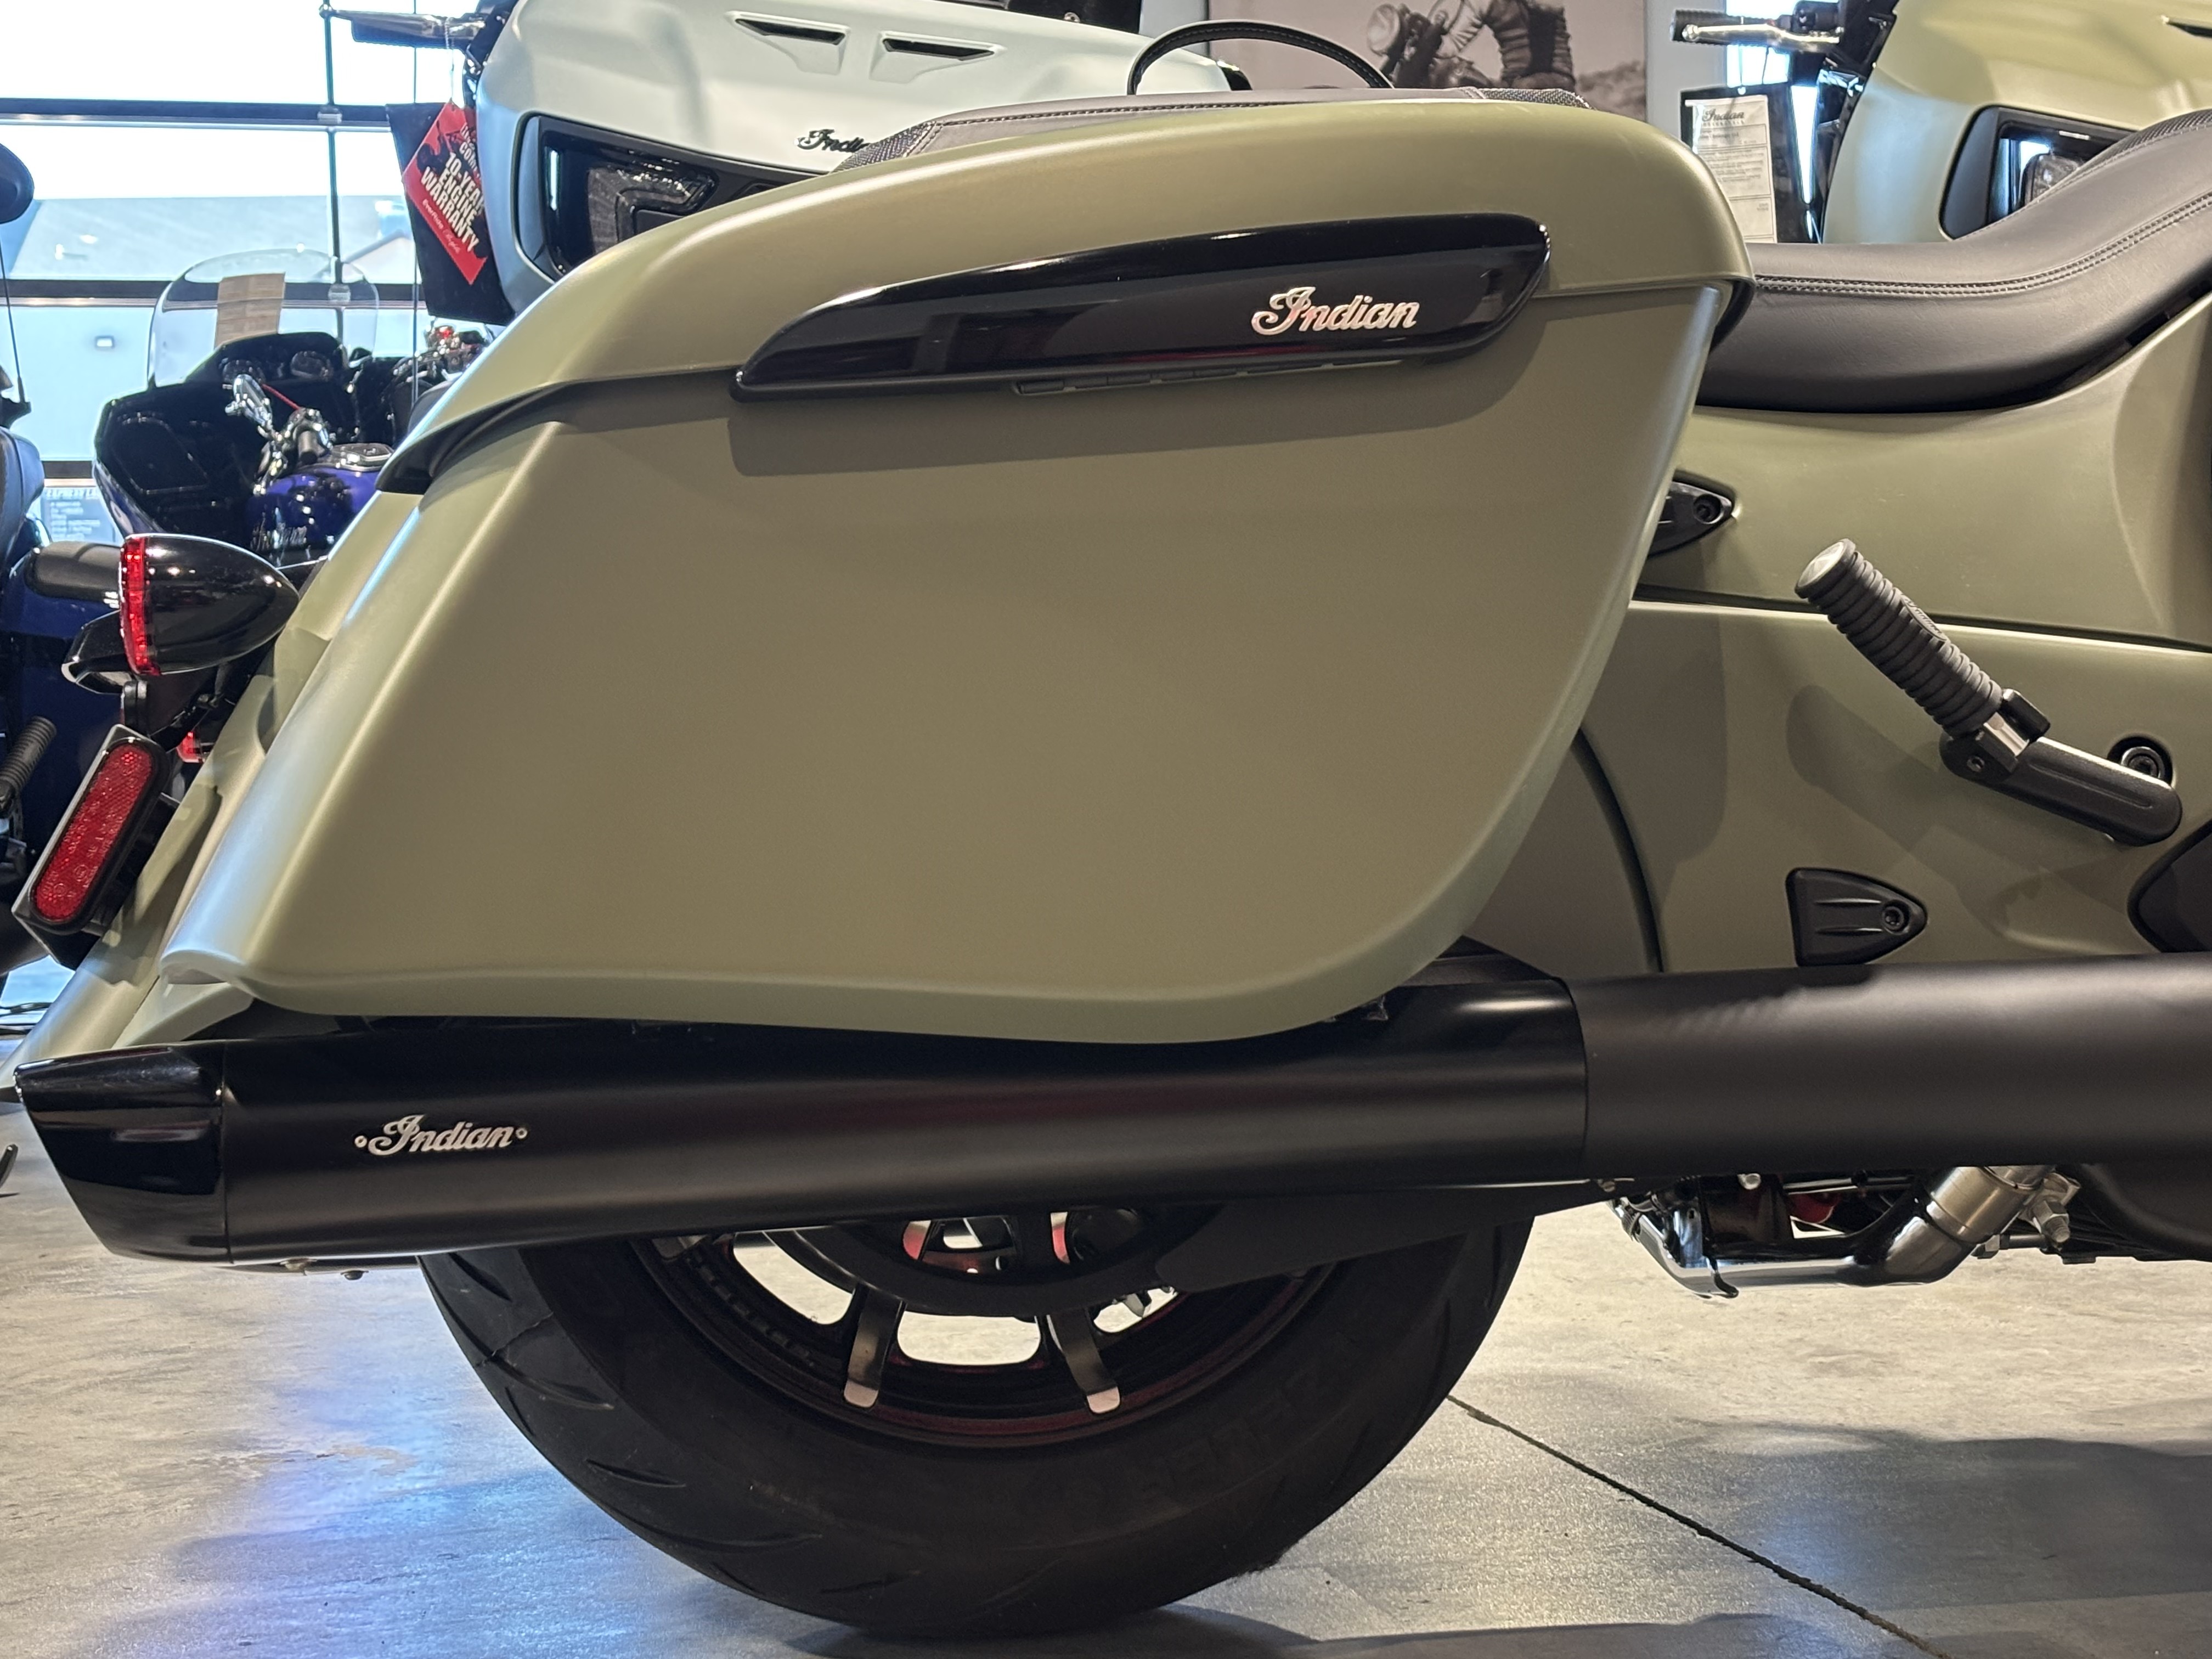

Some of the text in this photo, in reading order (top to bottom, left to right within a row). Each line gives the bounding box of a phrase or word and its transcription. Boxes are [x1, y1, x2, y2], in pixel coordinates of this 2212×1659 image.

[1702, 109, 1744, 121] Indian
[421, 166, 479, 252] WARRANTY
[438, 168, 477, 226] ENGINE
[1251, 286, 1420, 336] Indian
[368, 1114, 515, 1156] Indian
